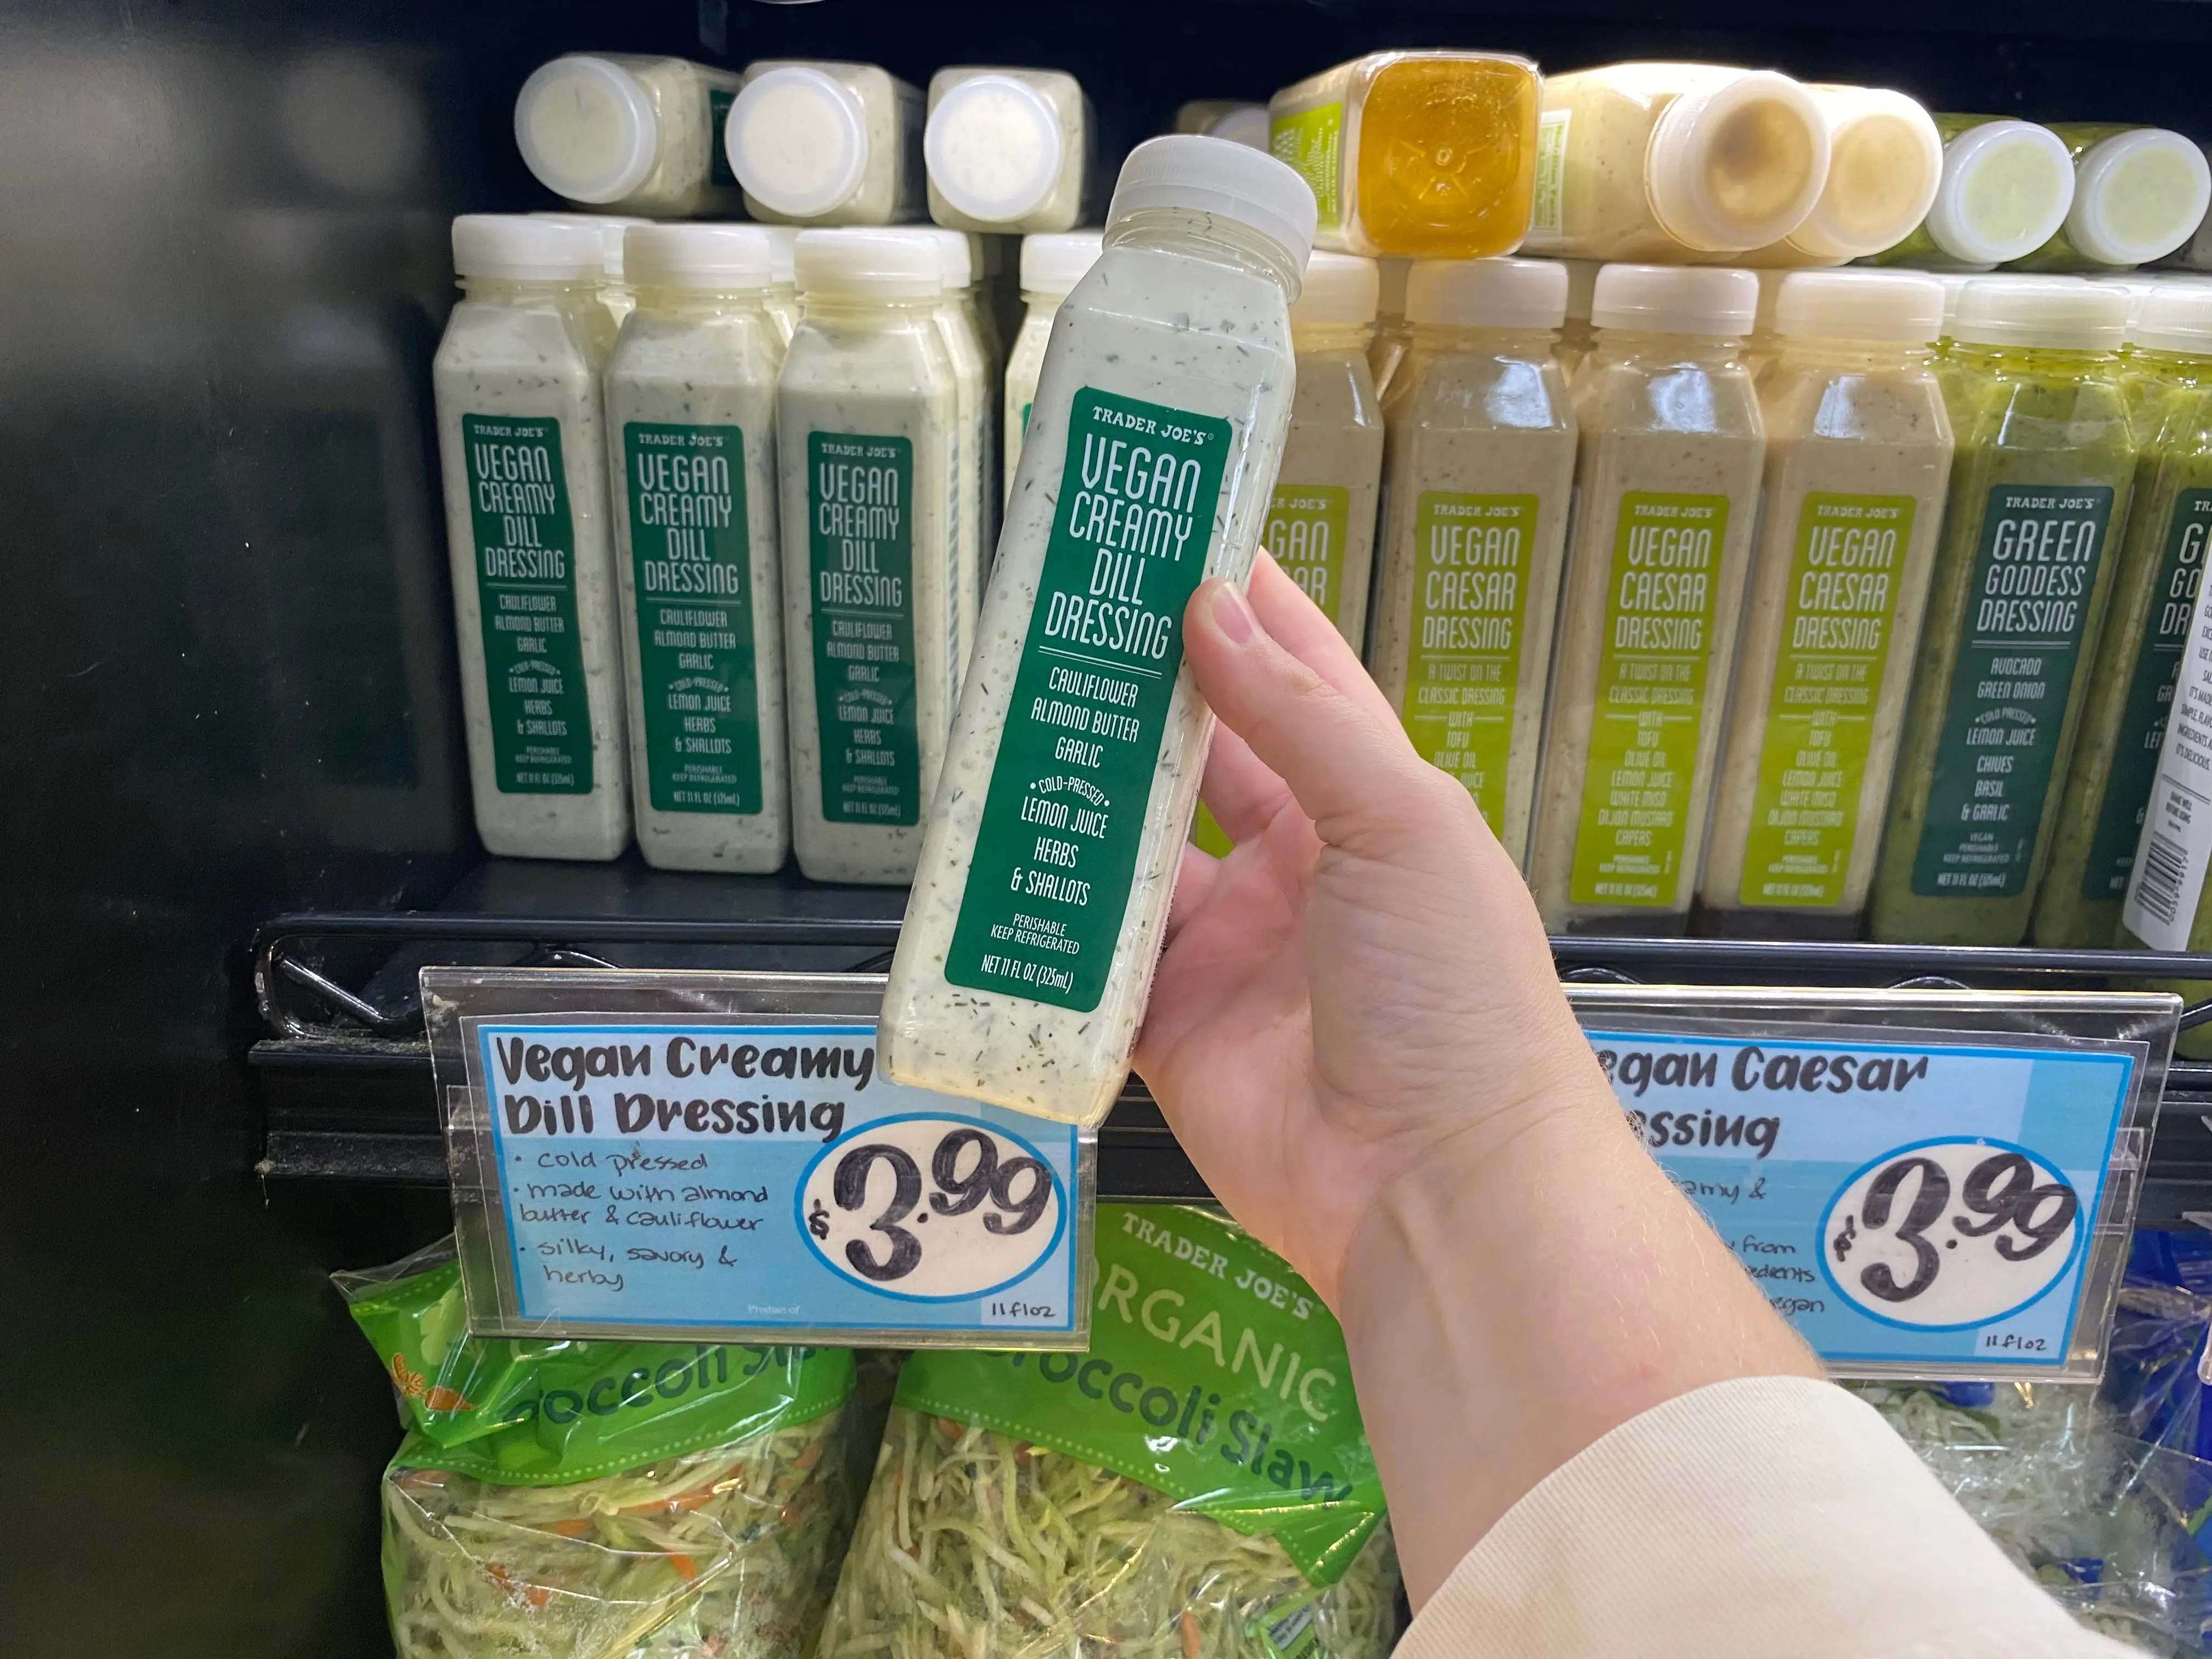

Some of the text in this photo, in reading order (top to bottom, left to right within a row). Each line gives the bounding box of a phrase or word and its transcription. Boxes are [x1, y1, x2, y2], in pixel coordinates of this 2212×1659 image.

[473, 424, 544, 437] TRADER JOE'S
[1092, 406, 1156, 435] TRADER
[639, 433, 724, 447] TRADER JOE'S
[822, 444, 896, 458] TRADER JOE'S
[475, 442, 551, 482] VEGAN
[637, 452, 729, 494] VEGAN
[1081, 433, 1201, 514] VEGAN
[478, 480, 556, 515] CREAMY
[820, 463, 899, 506] VEGAN
[640, 493, 732, 528] CREAMY
[1289, 499, 1327, 510] JOE'S
[1434, 504, 1521, 517] TRADER JOE'S
[1635, 505, 1713, 518] TRADER JOE'S
[1818, 504, 1863, 518] TRADER
[2006, 497, 2095, 509] TRADER JOE'S
[503, 515, 542, 548] DILL
[820, 503, 899, 540] CREAMY
[1069, 491, 1193, 562] CREAMY
[667, 528, 711, 562] DILL
[1268, 520, 1329, 561] GAN
[1431, 525, 1521, 567] VEGAN
[1628, 526, 1712, 568] VEGAN
[1808, 526, 1897, 568] VEGAN
[1993, 519, 2096, 562] GREEN
[485, 546, 565, 579] DRESSING
[842, 539, 879, 574] DILL
[644, 560, 739, 594] DRESSING
[820, 571, 902, 608] DRESSING
[1090, 548, 1146, 606] DILL
[1985, 564, 2086, 596] GODDESS
[499, 594, 556, 612] CAULIFLOWER
[1426, 571, 1517, 611] CAESAR
[1620, 572, 1707, 612] CAESAR
[1799, 571, 1889, 612] CAESAR
[495, 614, 565, 633] ALMOND BUTTER
[660, 608, 727, 627] CAULIFLOWER
[832, 619, 893, 640] CAULIFLOWER
[1045, 591, 1172, 659] DRESSING
[1977, 599, 2077, 633] DRESSING
[517, 637, 548, 653] GARLIC
[654, 630, 736, 649] ALMOND BUTTER
[1423, 616, 1513, 650] DRESSING
[1615, 616, 1703, 650] DRESSING
[1793, 616, 1882, 650] DRESSING
[679, 653, 713, 670] GARLIC
[827, 642, 899, 662] ALMOND BUTTER
[848, 665, 879, 682] GARLIC
[1439, 664, 1466, 680] TWIST
[1470, 665, 1482, 680] ON
[1486, 664, 1502, 681] THE
[1990, 657, 2042, 675] AVOCADO
[509, 676, 564, 694] LEMON JUICE
[1048, 667, 1139, 708] CAULIFLOWER
[1419, 687, 1505, 706] CLASSIC DRESSING
[1977, 681, 2046, 699] GREEN ONION
[524, 699, 552, 715] HERBS
[668, 693, 731, 712] LEMON JUICE
[838, 705, 894, 724] LEMON JUICE
[517, 719, 567, 736] & SHALLOTS
[684, 716, 716, 733] HERBS
[1030, 697, 1140, 743] ALMOND BUTTER
[1448, 711, 1473, 727] WITH
[675, 737, 731, 754] & SHALLOTS
[854, 729, 882, 746] HERBS
[1446, 731, 1470, 748] TOFU
[1967, 727, 2037, 746] LEMON JUICE
[846, 749, 895, 765] & SHALLOTS
[1055, 737, 1104, 768] GARLIC
[1463, 753, 1476, 769] OIL
[1977, 755, 2013, 774] CHIVES
[1038, 775, 1105, 806] COLD-PRESSED
[1974, 780, 2004, 798] BASIL
[1021, 795, 1109, 839] LEMON JUICE
[1961, 804, 2010, 821] & GARLIC
[1034, 836, 1079, 868] HERBS
[1011, 867, 1090, 906] & SHALLOTS
[1013, 913, 1066, 937] PERISHABLE
[991, 924, 1080, 955] KEEP REFRIGERATED
[981, 954, 1074, 994] NET 11 FL OZ (325mL)
[496, 1036, 874, 1091] Vegan Creamy
[1596, 1046, 1929, 1098] egan Caesar
[504, 1092, 845, 1142] Dill Dressing
[537, 1151, 709, 1176] cold pressed
[527, 1182, 769, 1203] made with almond
[1748, 1177, 1767, 1199] &
[521, 1205, 764, 1231] butter & cauliflower
[537, 1238, 738, 1269] silky, savory &
[1742, 1234, 1796, 1254] from
[544, 1265, 624, 1291] herby
[1121, 1211, 1316, 1320] TRADER JOE'S
[747, 1304, 800, 1314] Product of
[1769, 1296, 1825, 1316] egan
[1096, 1262, 1337, 1424] RGANIC
[1014, 1351, 1352, 1503] occoli Slaw
